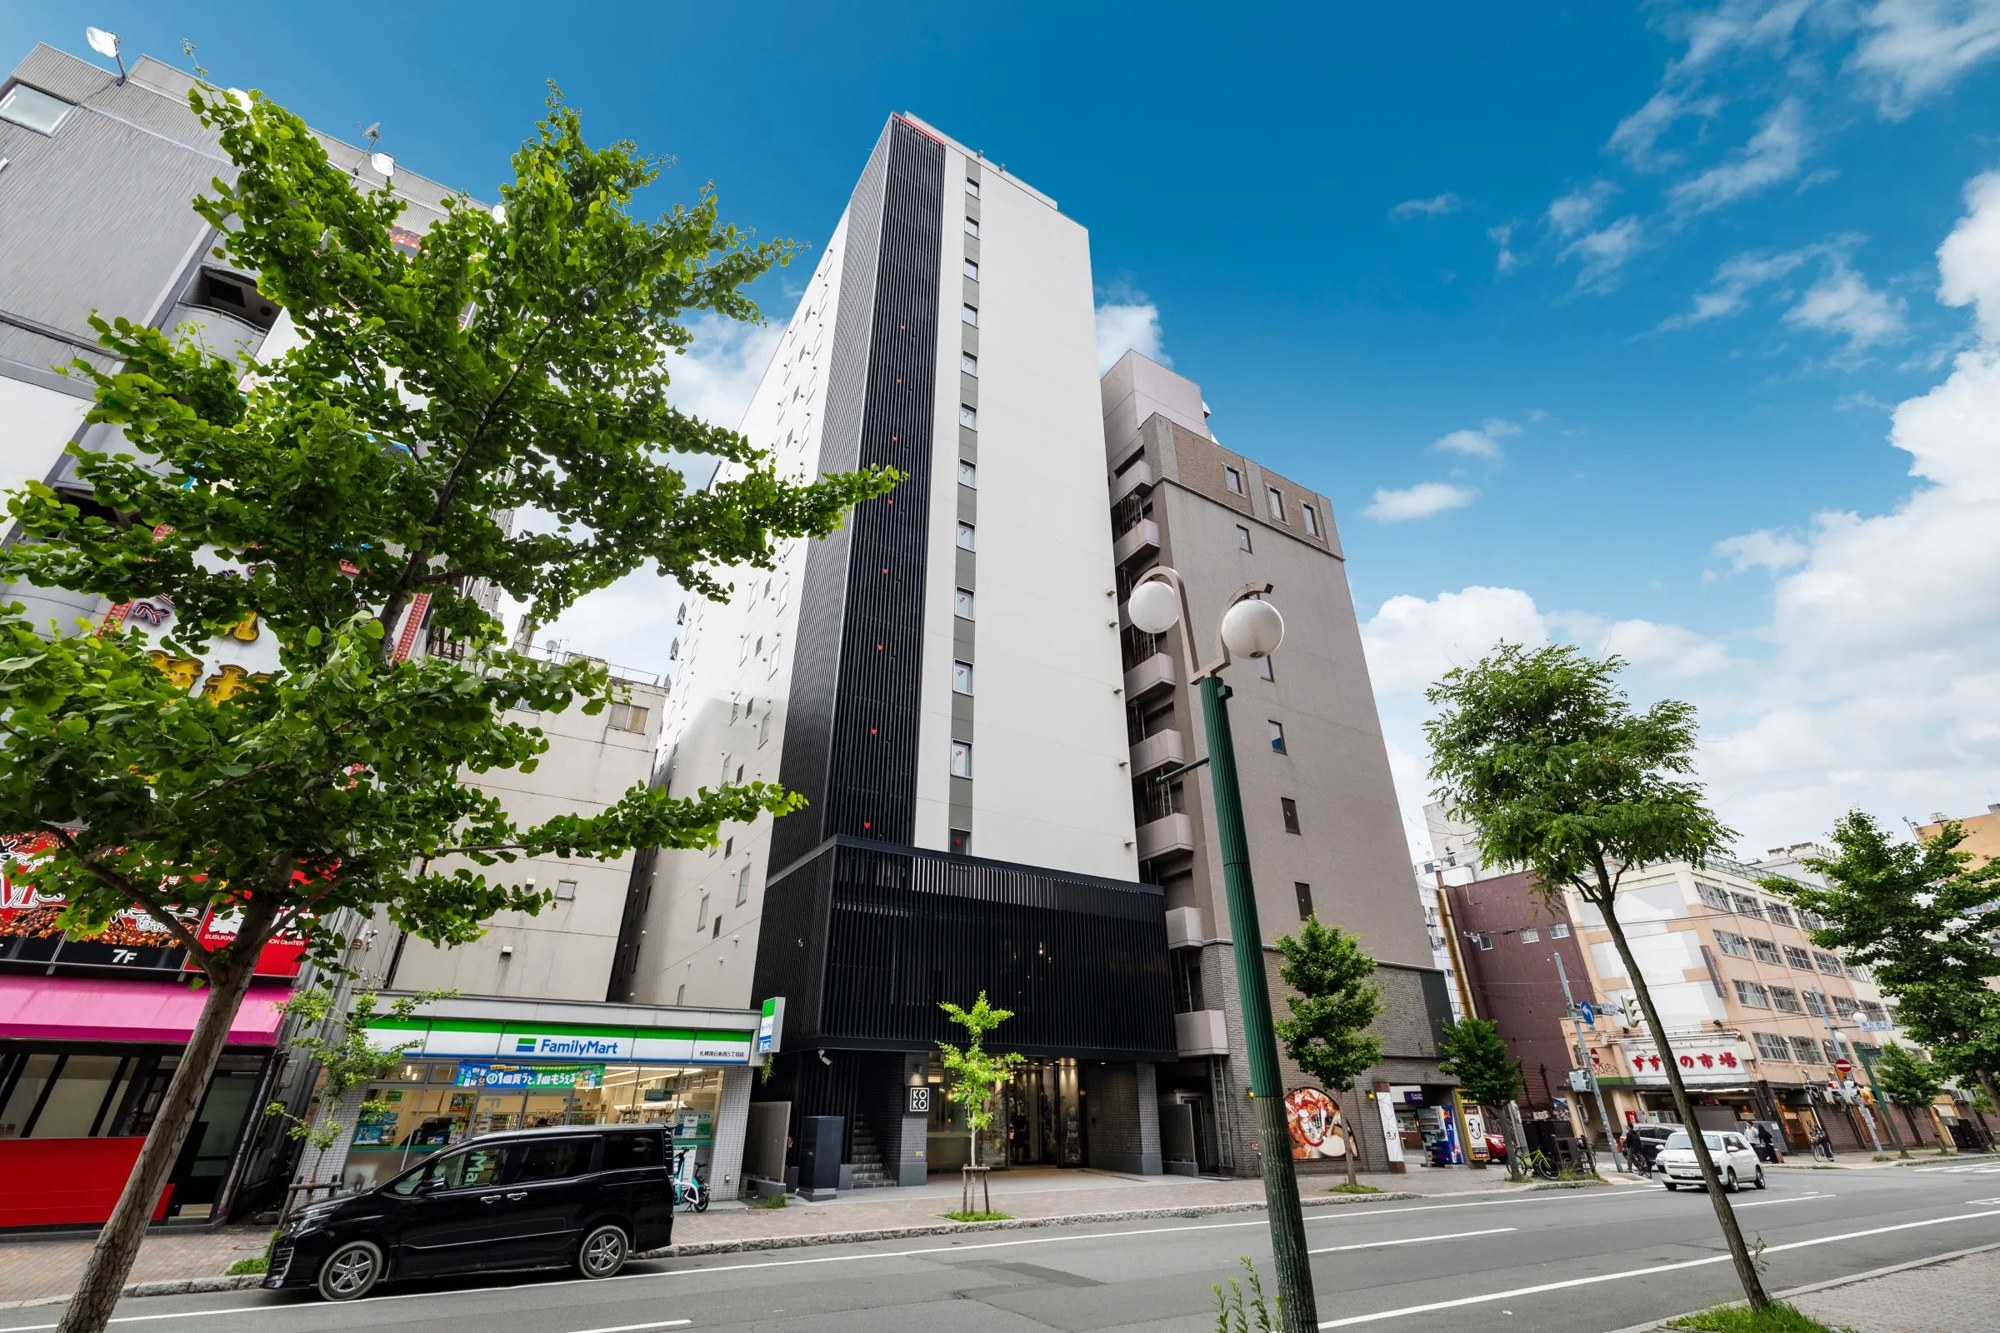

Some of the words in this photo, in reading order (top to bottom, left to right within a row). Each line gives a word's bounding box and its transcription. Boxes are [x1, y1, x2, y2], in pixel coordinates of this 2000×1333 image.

[112, 948, 138, 964] 7F
[540, 1039, 619, 1055] FamilyMart
[1631, 1051, 1738, 1072] すすの市場
[912, 1089, 927, 1100] KO
[912, 1099, 927, 1110] KO
